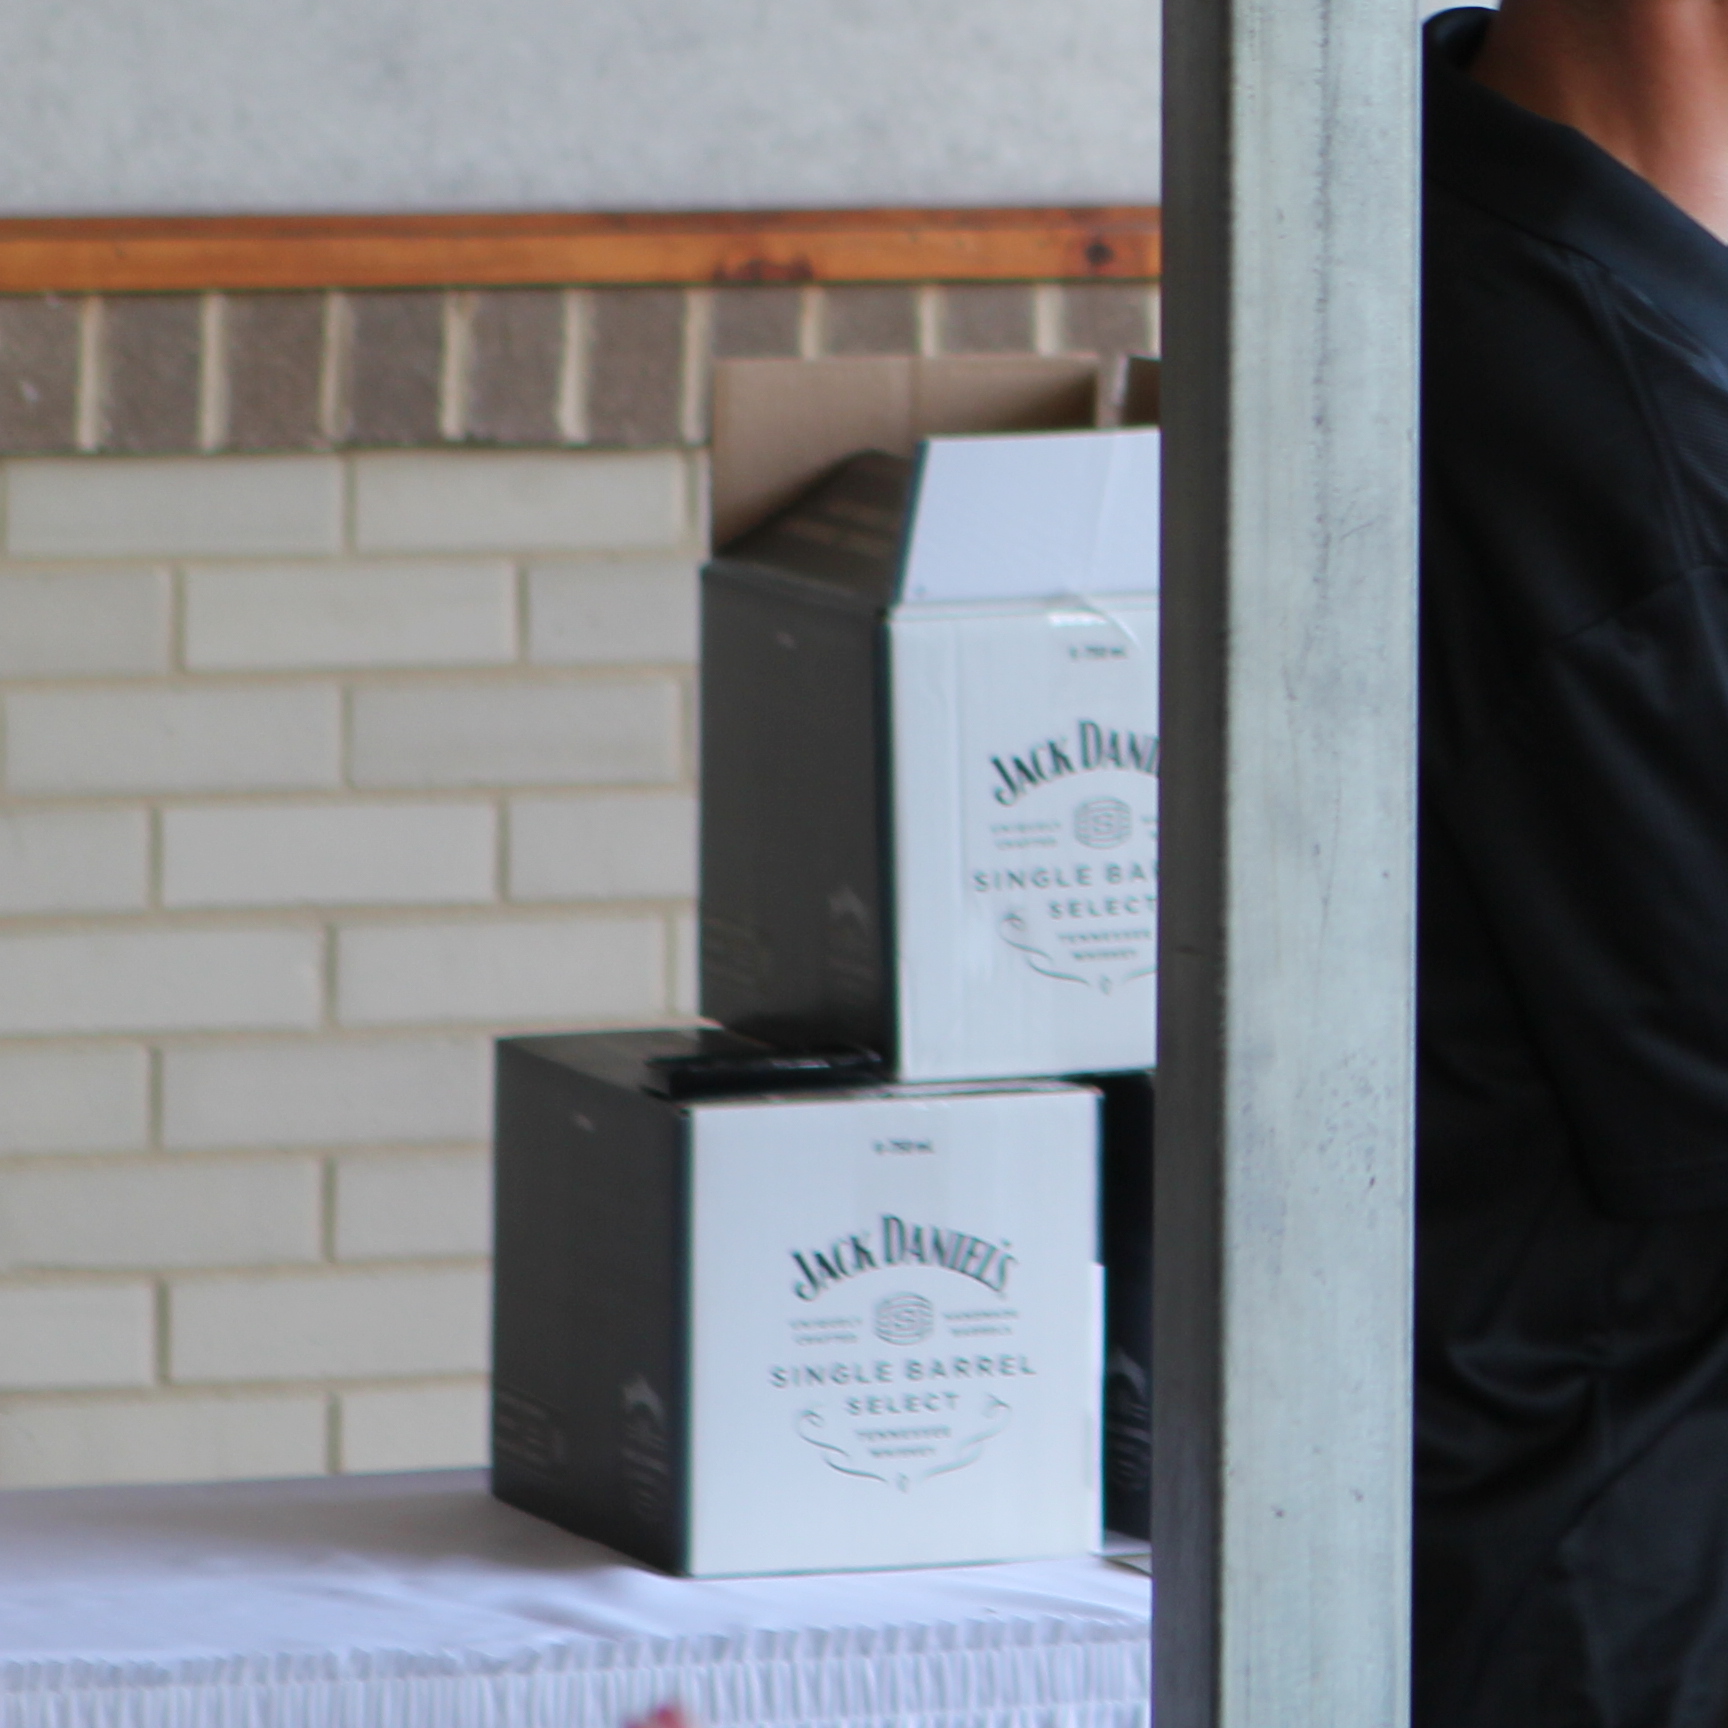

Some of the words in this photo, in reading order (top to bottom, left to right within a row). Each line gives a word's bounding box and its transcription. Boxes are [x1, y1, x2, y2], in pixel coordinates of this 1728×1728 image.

[990, 737, 1076, 807] JACK
[1077, 718, 1159, 779] DANI
[973, 864, 1092, 892] SINGLE
[1048, 894, 1158, 920] SELECT
[789, 1230, 880, 1302] JACK
[769, 1360, 895, 1389] SINGLE
[903, 1353, 1037, 1382] BARREL
[846, 1391, 960, 1416] SELECT
